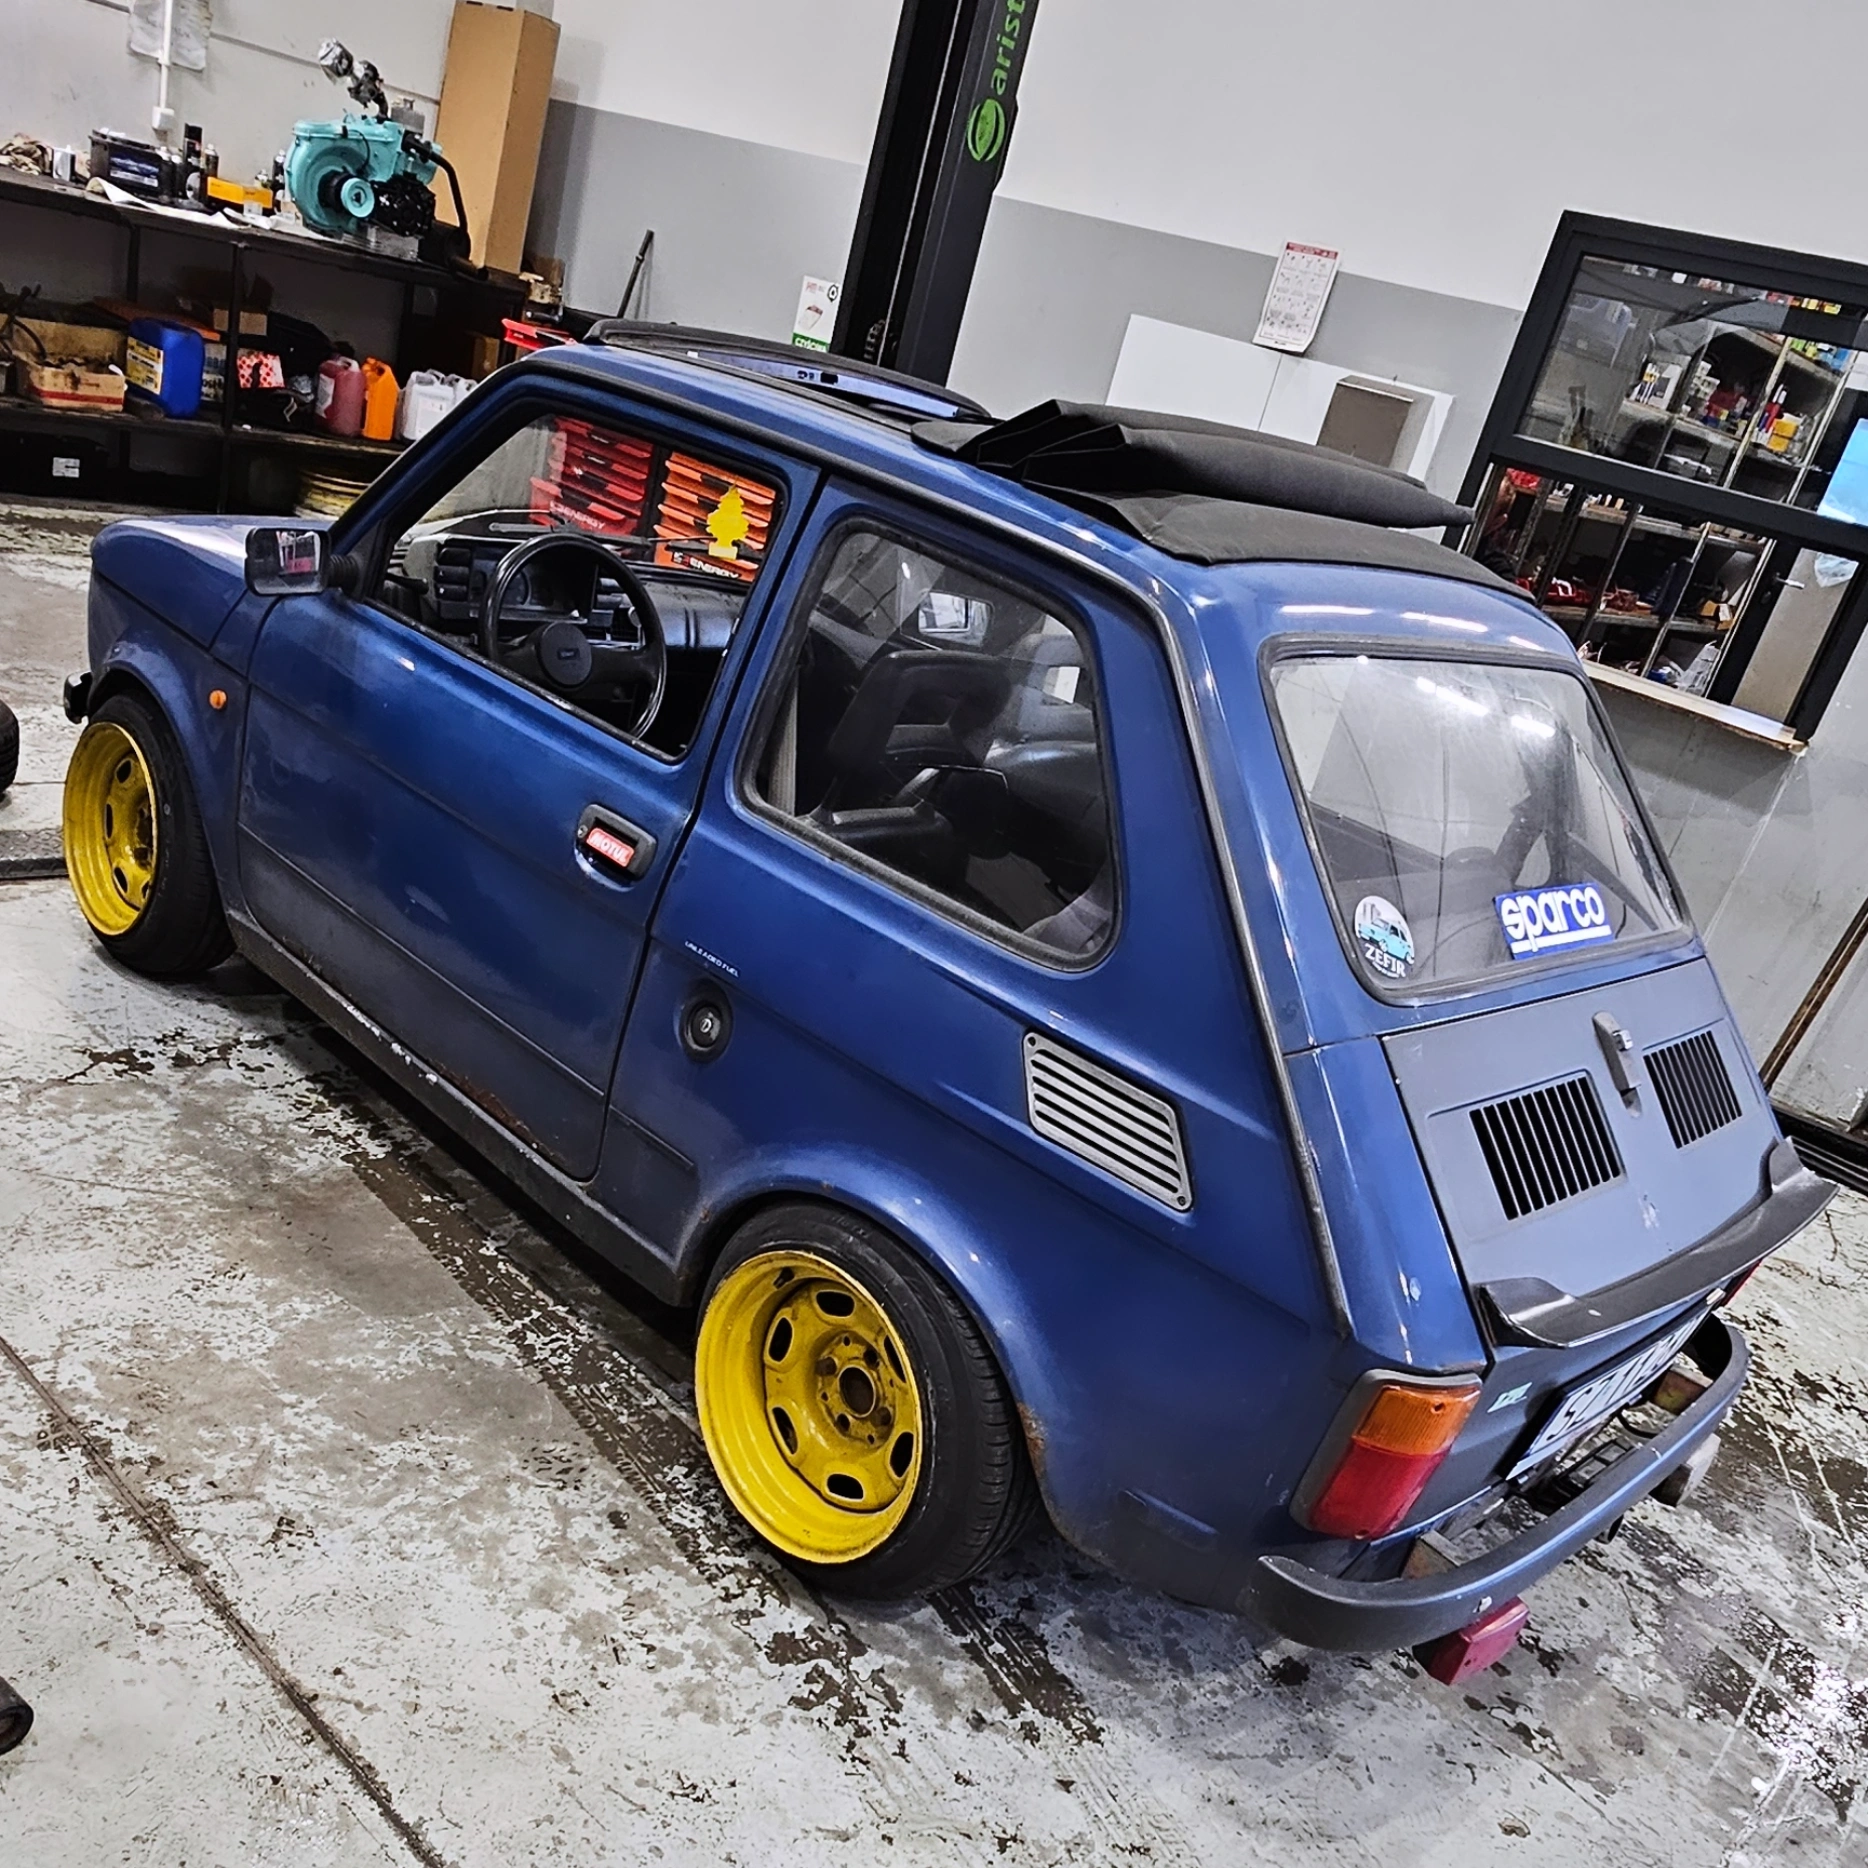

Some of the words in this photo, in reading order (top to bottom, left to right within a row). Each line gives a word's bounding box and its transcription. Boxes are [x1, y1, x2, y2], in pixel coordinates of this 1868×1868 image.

[588, 830, 631, 864] MOTUL
[1501, 886, 1606, 952] sparco
[1364, 942, 1407, 978] ZEFIR
